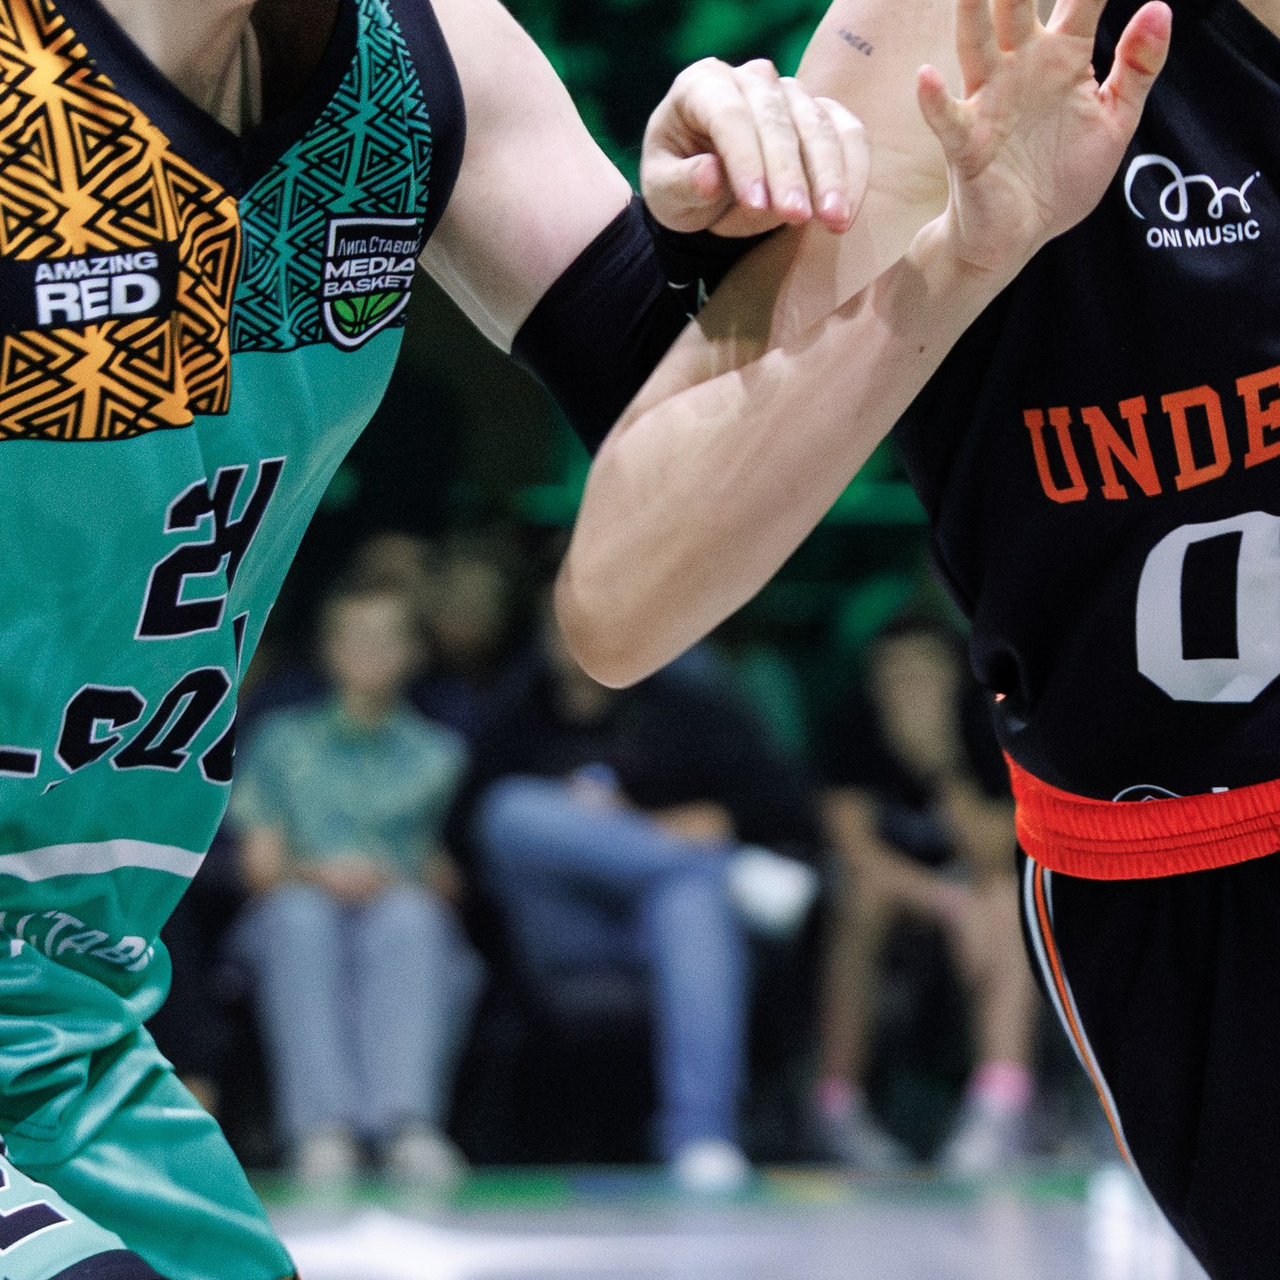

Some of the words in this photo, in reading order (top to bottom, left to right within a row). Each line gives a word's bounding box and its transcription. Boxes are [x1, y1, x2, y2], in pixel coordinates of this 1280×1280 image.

[1146, 227, 1183, 248] ONI
[1184, 219, 1261, 248] MUSIC
[35, 251, 159, 283] AMAZING
[325, 257, 415, 280] MEDIA
[35, 273, 161, 325] RED
[323, 274, 414, 297] BASKET
